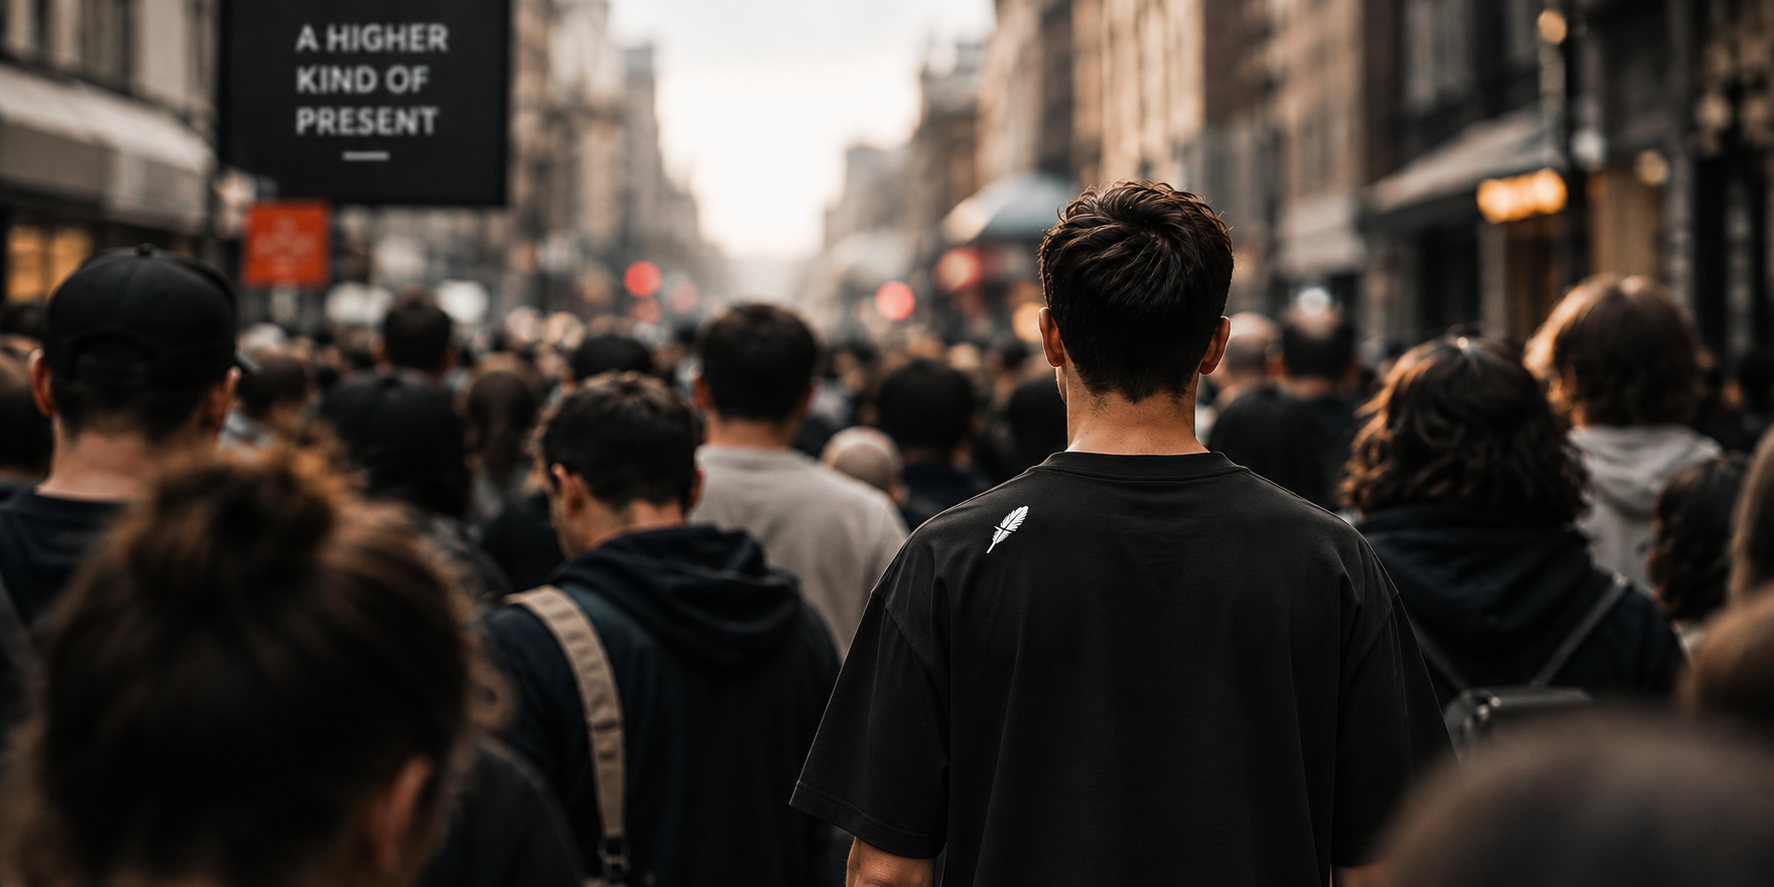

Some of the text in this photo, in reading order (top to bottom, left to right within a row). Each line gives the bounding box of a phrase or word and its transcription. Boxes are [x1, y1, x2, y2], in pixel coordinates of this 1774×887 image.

[296, 24, 449, 52] A HIGHER
[296, 65, 430, 93] KIND OF
[296, 107, 438, 135] PRESENT
